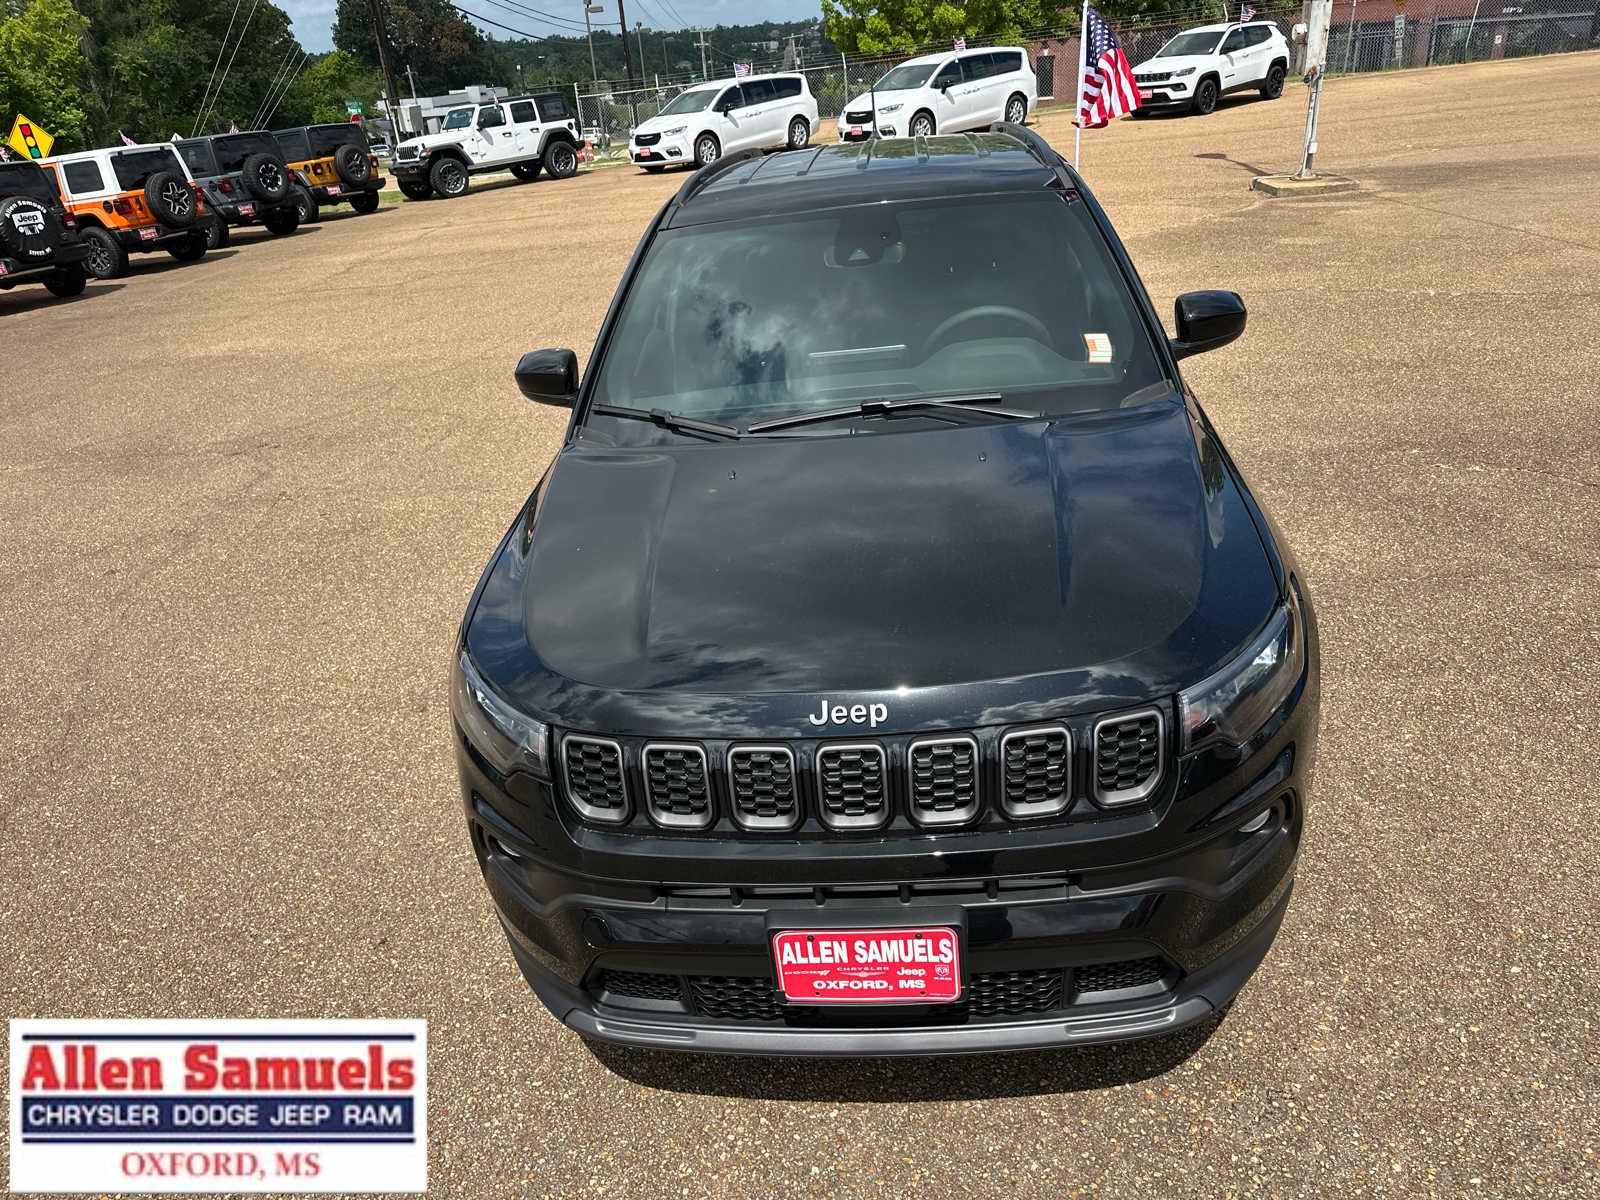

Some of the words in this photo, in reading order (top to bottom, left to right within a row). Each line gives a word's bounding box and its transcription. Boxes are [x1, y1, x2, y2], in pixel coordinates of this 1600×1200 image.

[17, 214, 38, 223] Jeep
[809, 700, 888, 728] Jeep
[782, 940, 849, 965] ALLEN
[854, 938, 953, 964] SAMUELS
[896, 966, 927, 977] Jeep
[813, 979, 894, 991] OXFORD,
[898, 979, 926, 990] MS
